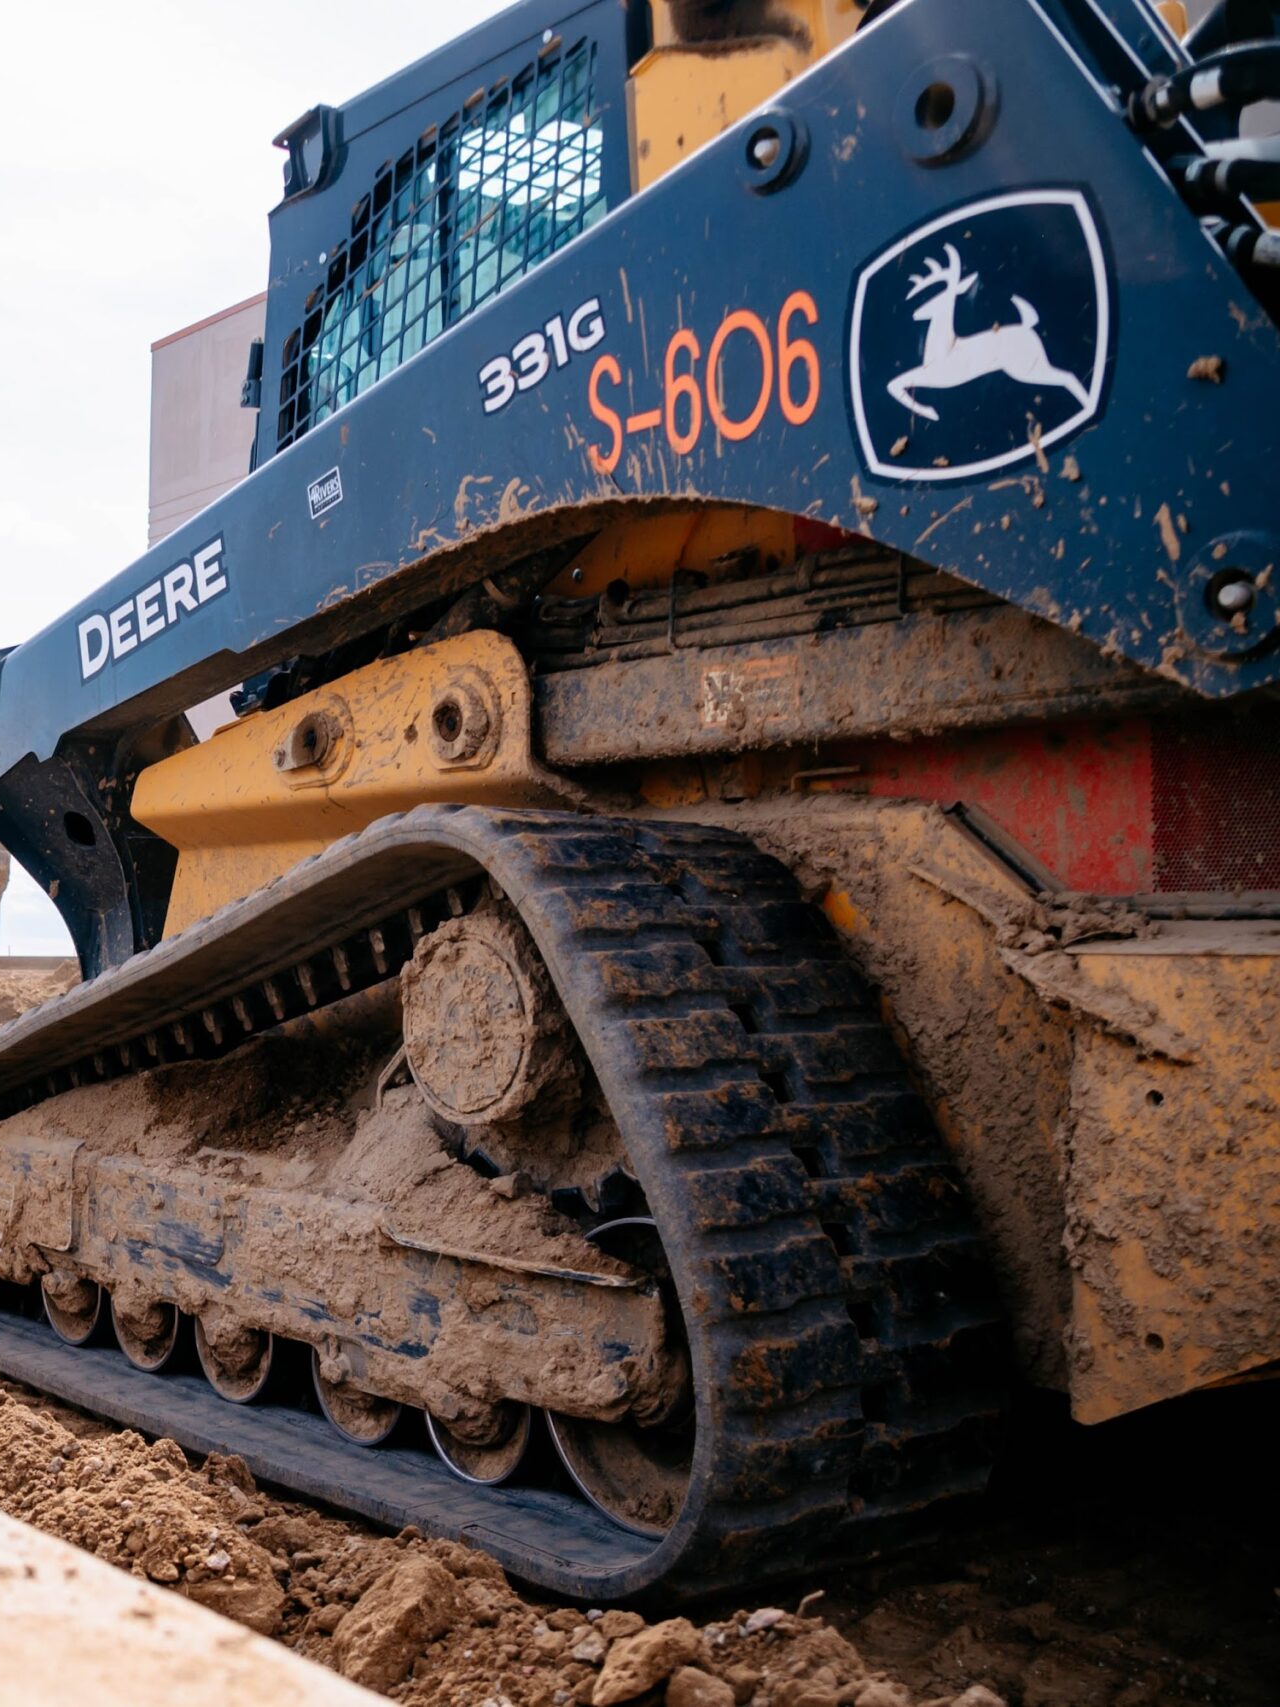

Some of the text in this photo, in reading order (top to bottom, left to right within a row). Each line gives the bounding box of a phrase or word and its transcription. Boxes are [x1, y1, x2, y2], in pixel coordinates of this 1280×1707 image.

[478, 297, 606, 414] 331G
[587, 289, 821, 476] S-606
[78, 537, 228, 681] DEERE
